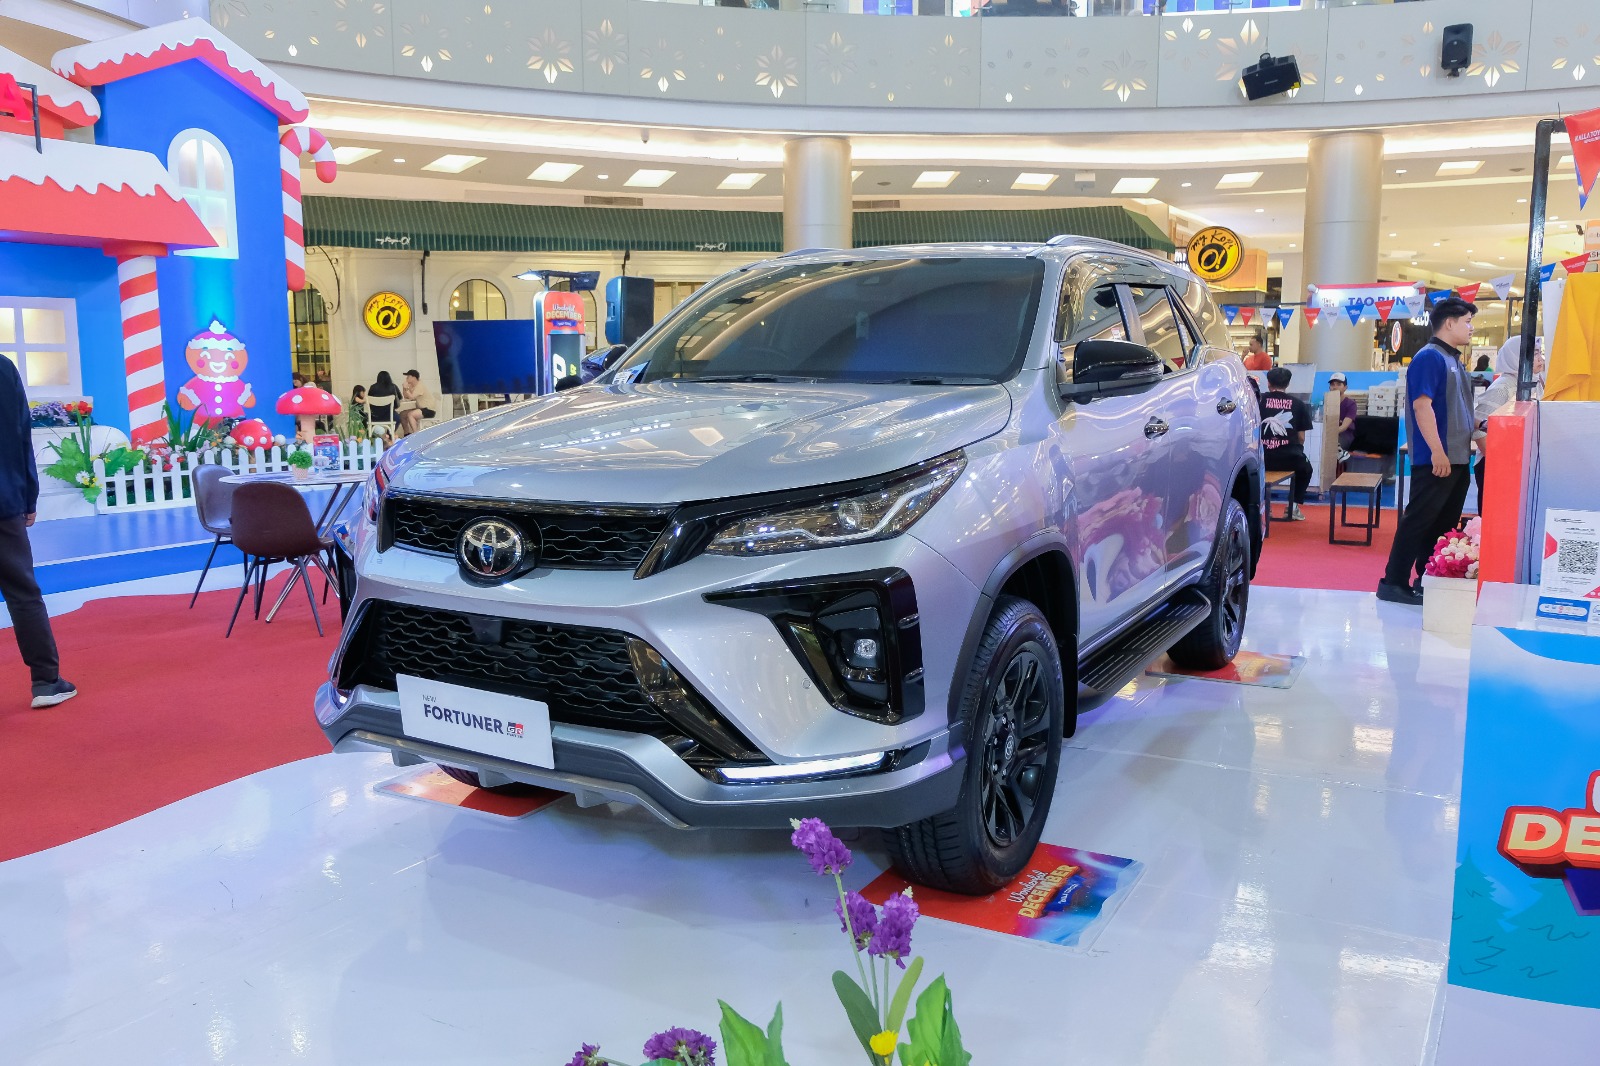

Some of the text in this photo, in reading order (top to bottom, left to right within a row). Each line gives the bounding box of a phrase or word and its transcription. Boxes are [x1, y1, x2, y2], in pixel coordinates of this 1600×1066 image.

[1191, 230, 1237, 251] my Kopi
[368, 299, 380, 313] my
[1348, 297, 1374, 306] TAO
[546, 311, 582, 320] DECEMBER
[423, 695, 436, 703] NEW
[423, 703, 504, 734] FORTUNER
[1018, 864, 1079, 918] DECEMBER
